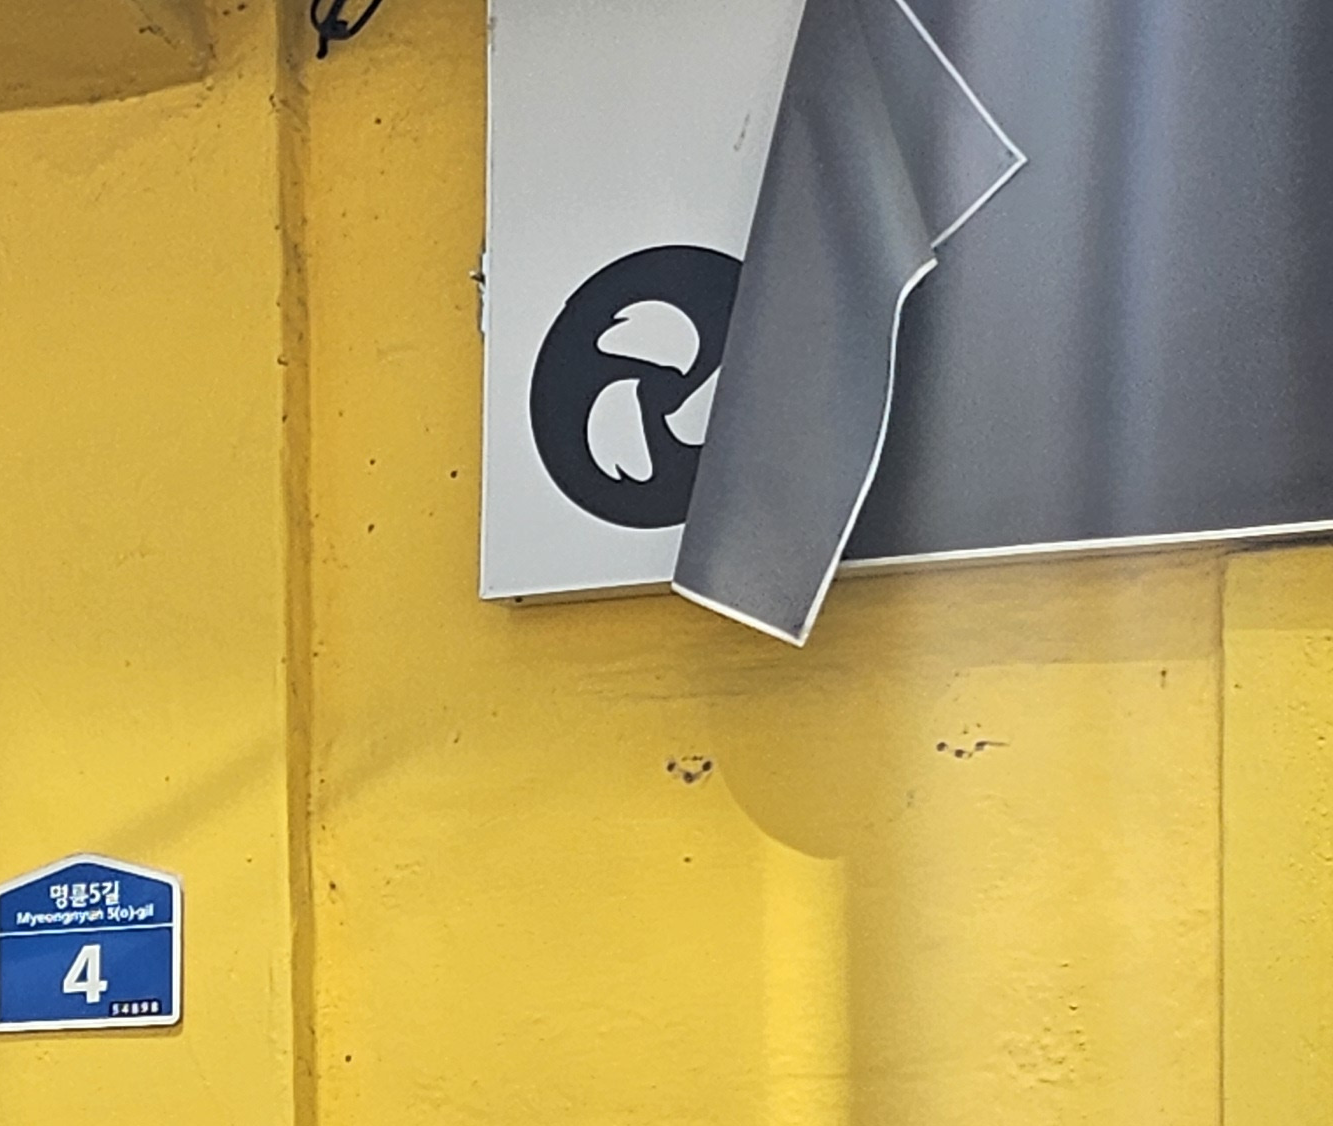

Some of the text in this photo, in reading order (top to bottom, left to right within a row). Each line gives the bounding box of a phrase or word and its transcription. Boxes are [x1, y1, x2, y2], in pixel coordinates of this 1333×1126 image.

[49, 880, 120, 909] 명륜5길
[106, 903, 154, 923] 5(o)-gil
[62, 943, 108, 1004] 4
